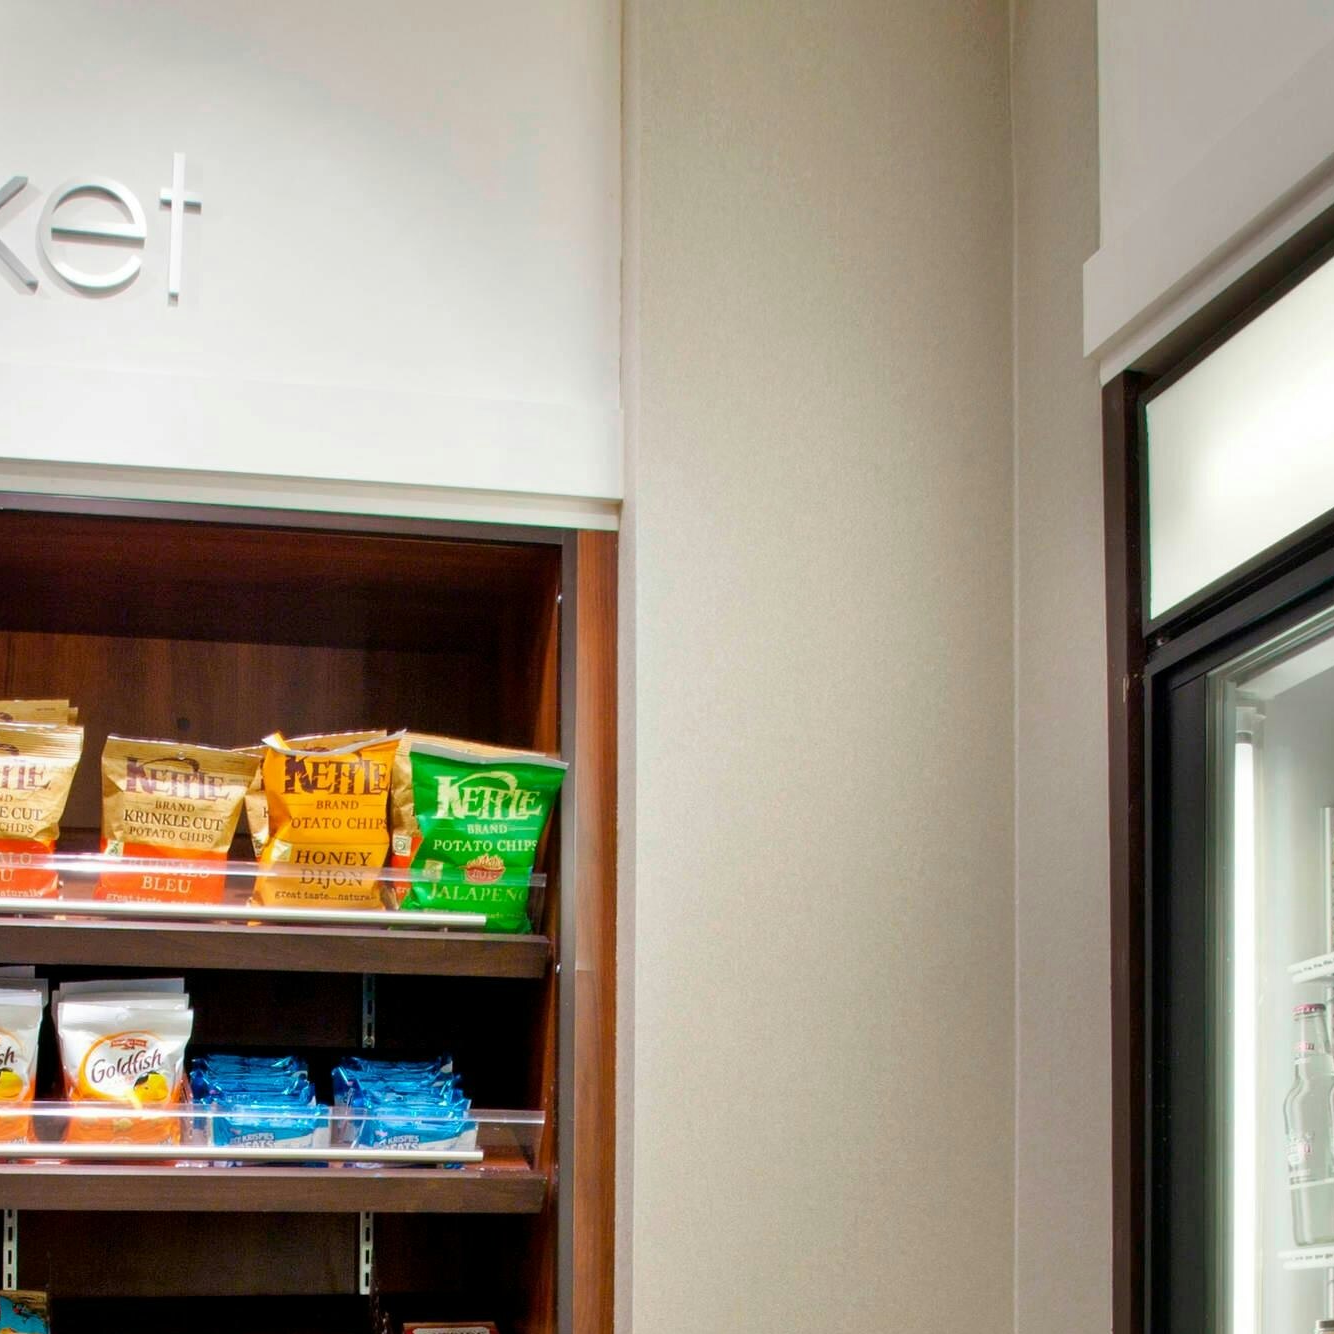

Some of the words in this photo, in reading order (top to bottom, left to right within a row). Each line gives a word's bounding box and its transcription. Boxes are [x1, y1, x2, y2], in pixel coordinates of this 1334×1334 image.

[125, 757, 232, 801] KETTLE
[284, 755, 391, 796] KETTLE
[317, 800, 359, 810] BRAND
[432, 774, 544, 820] KETTLE
[11, 808, 43, 821] CUT
[155, 801, 195, 812] BRAND
[123, 810, 188, 827] KRINKLE
[192, 817, 224, 831] CUT
[128, 827, 176, 840] POTATO
[180, 831, 214, 843] CHIPS
[468, 824, 507, 834] BRAND
[434, 840, 491, 852] POTATO
[496, 839, 537, 852] CHIPS
[295, 850, 372, 866] HONEY
[143, 876, 191, 893] BLEU
[91, 1048, 163, 1084] Goldfish
